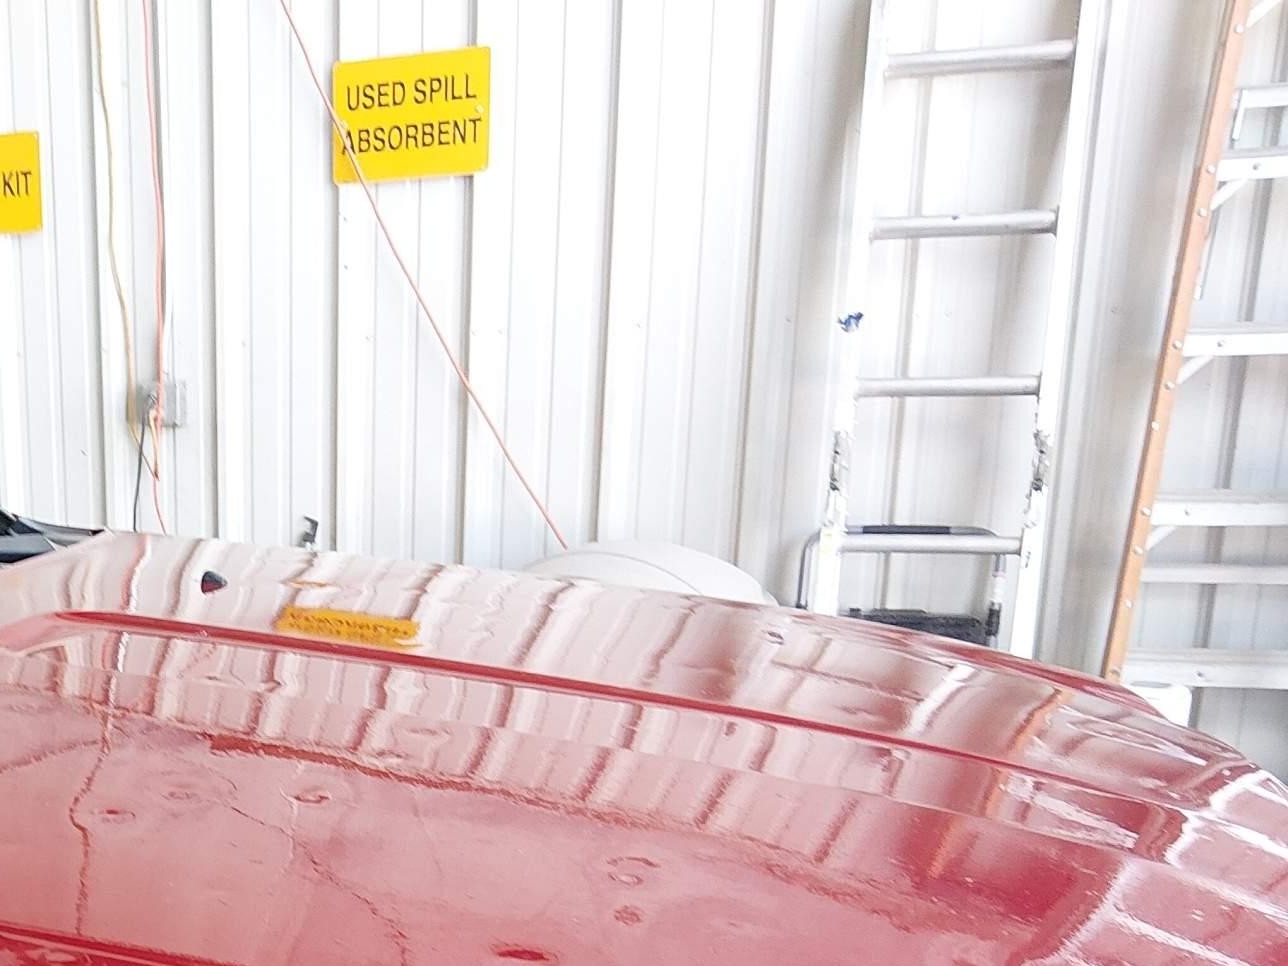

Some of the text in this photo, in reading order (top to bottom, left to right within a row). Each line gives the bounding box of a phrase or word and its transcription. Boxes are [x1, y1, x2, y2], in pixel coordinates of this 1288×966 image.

[347, 74, 477, 111] USED SPILL
[341, 118, 481, 155] ABSORBENT
[2, 171, 32, 197] KIT
